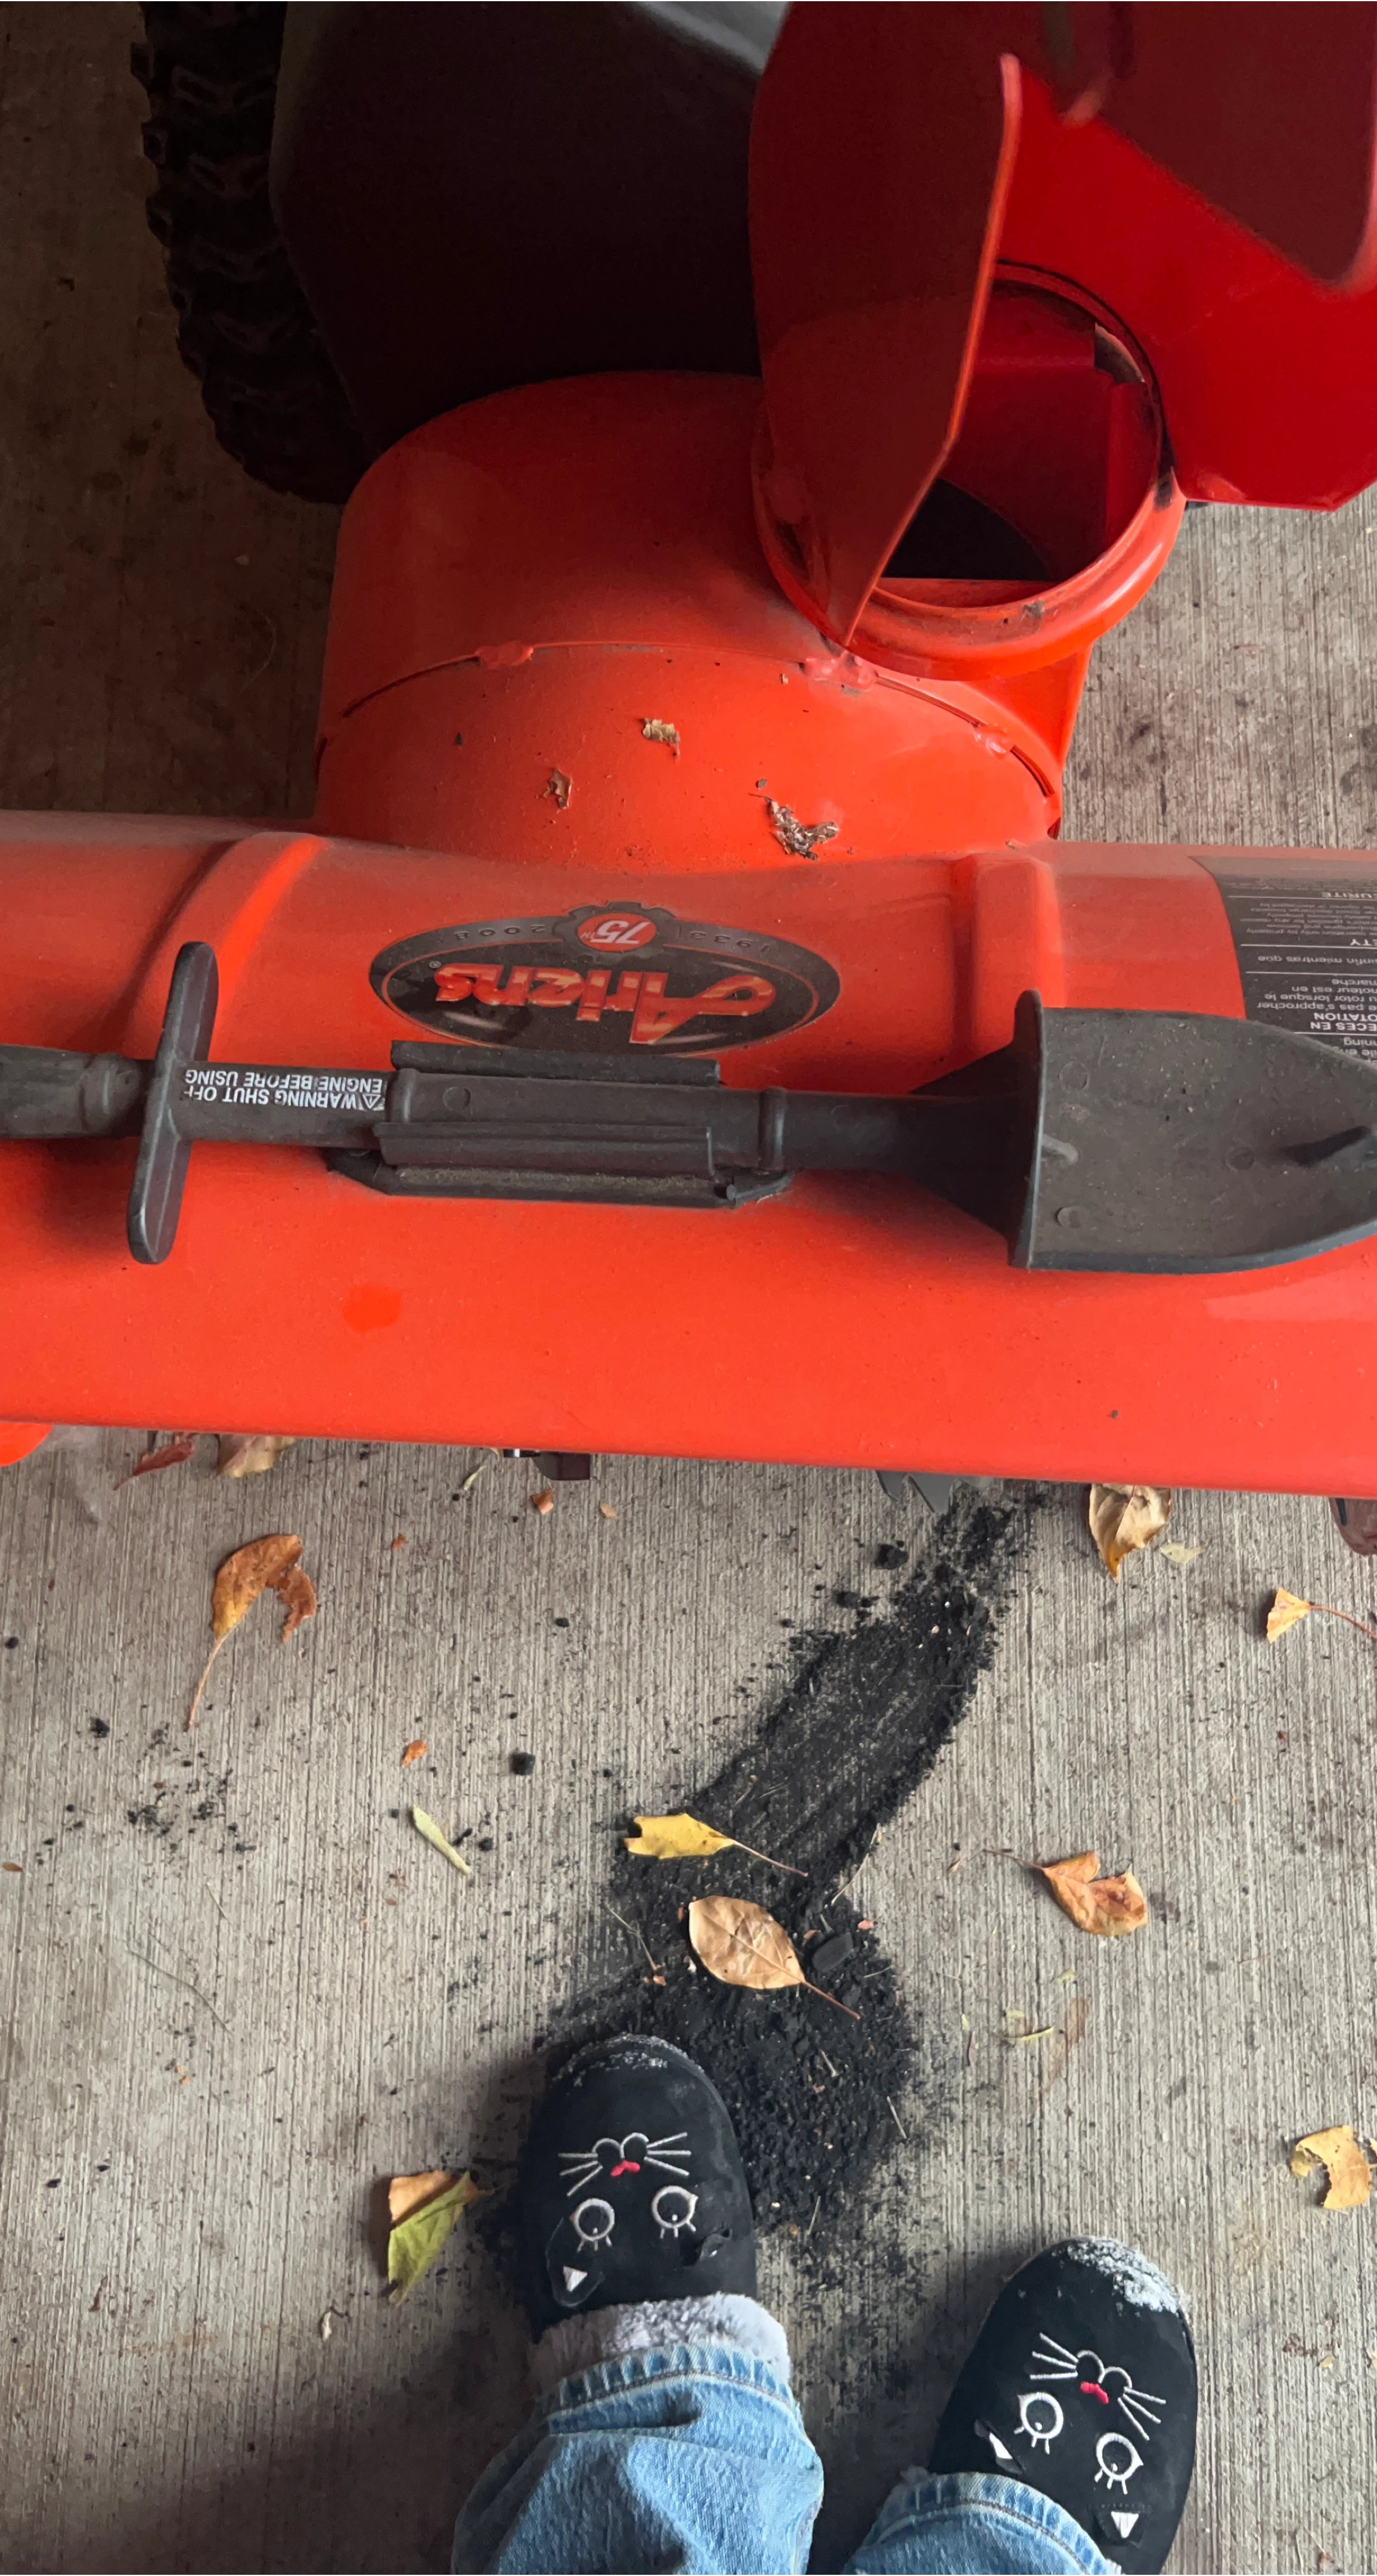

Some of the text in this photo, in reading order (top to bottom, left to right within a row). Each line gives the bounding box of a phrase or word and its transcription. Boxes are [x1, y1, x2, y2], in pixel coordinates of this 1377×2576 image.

[434, 962, 776, 1045] Ariens
[1280, 993, 1330, 1002] lorsque
[1257, 1002, 1335, 1011] s'approcher
[1310, 1021, 1331, 1030] EN
[185, 1069, 383, 1094] ENGINE BEFORE USING
[222, 1088, 270, 1104] SHUT
[274, 1090, 356, 1109] WARNING
